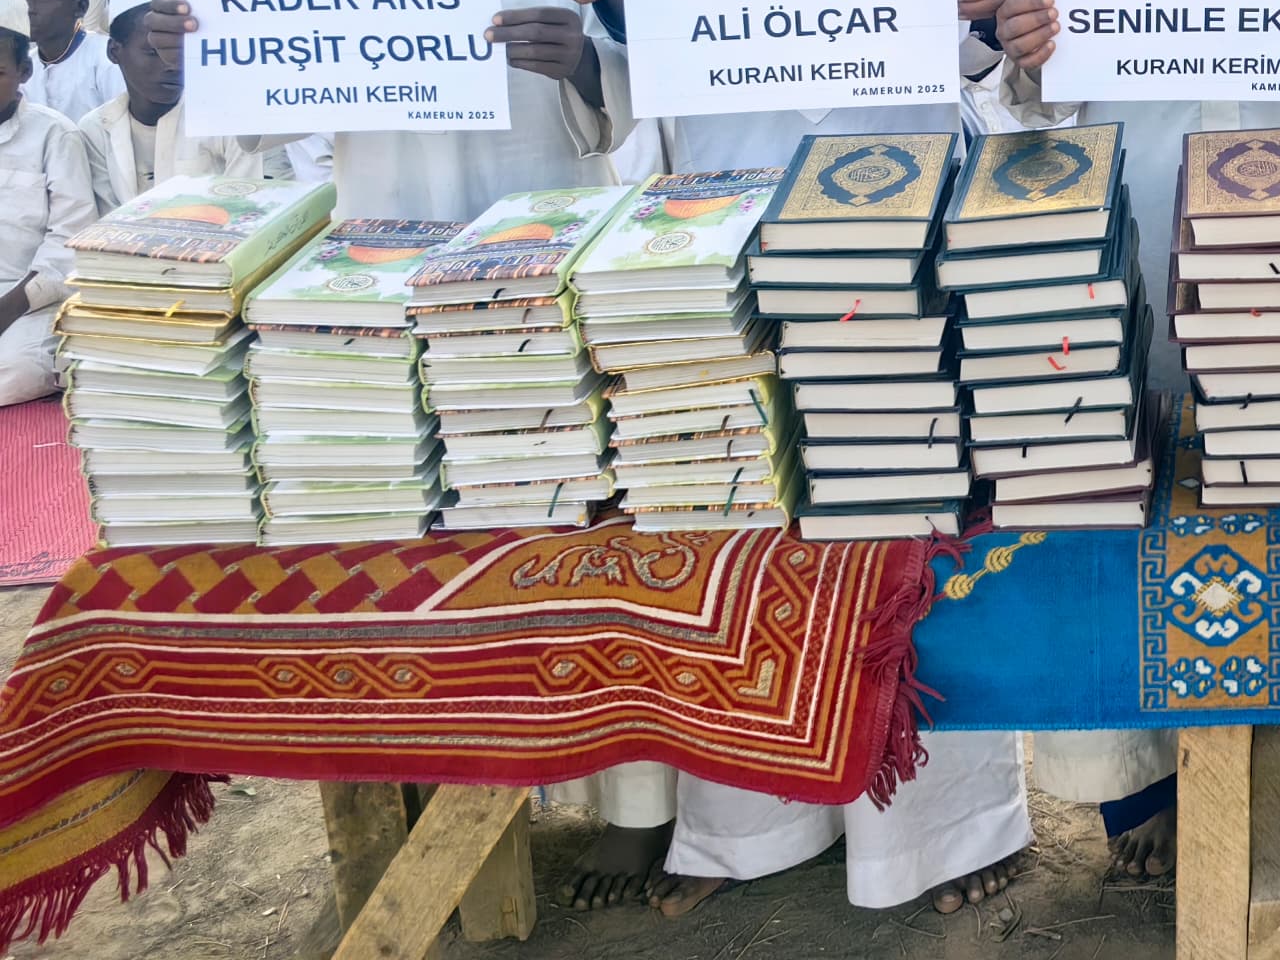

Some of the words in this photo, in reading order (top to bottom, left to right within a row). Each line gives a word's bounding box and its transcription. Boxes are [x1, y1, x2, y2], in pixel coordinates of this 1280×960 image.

[691, 7, 750, 42] ALİ
[764, 5, 898, 42] ÖLÇAR
[1068, 3, 1225, 33] SENİNLE
[202, 30, 345, 71] HURŞİT
[360, 35, 493, 70] ÇORLU
[710, 65, 802, 86] KURANI
[811, 58, 885, 80] KERİM
[1117, 58, 1204, 75] KURANI
[267, 87, 357, 106] KURANI
[367, 82, 437, 102] KERİM
[852, 85, 913, 97] KAMERUN
[917, 84, 945, 94] 2025
[407, 111, 464, 120] KAMERUN
[468, 111, 495, 120] 2025
